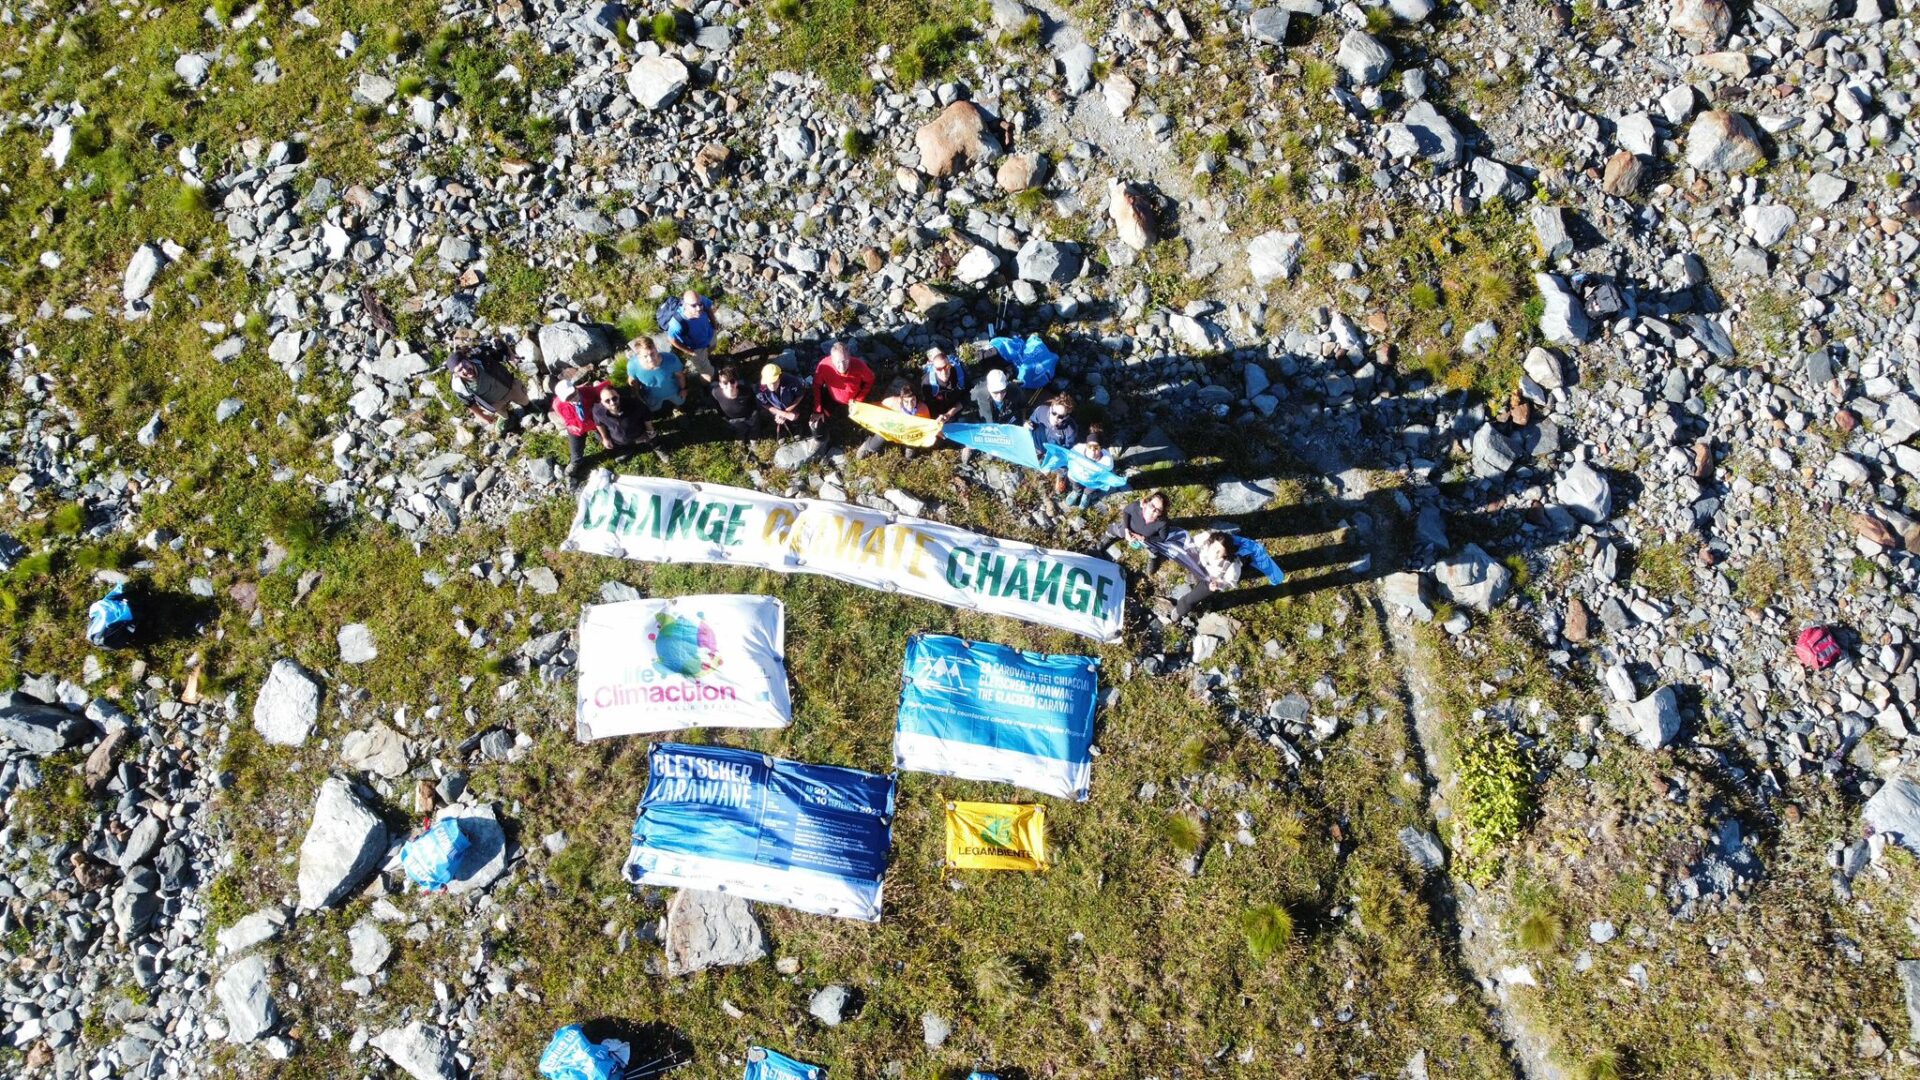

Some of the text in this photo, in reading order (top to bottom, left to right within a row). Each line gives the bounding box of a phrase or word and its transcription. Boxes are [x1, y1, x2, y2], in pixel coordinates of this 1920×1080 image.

[583, 488, 1113, 620] CHANGE CIMATE CHANGE
[624, 666, 654, 684] life
[993, 663, 1036, 681] CAROVANA
[1038, 674, 1052, 684] DEI
[595, 679, 736, 709] Climaction
[977, 688, 993, 702] THE
[1036, 697, 1075, 715] CARAVAN
[653, 754, 752, 785] GLETSCHER
[814, 787, 827, 796] 20
[816, 796, 827, 806] 10
[859, 806, 882, 817] 2023
[958, 846, 1033, 858] LEGAMBIENTE
